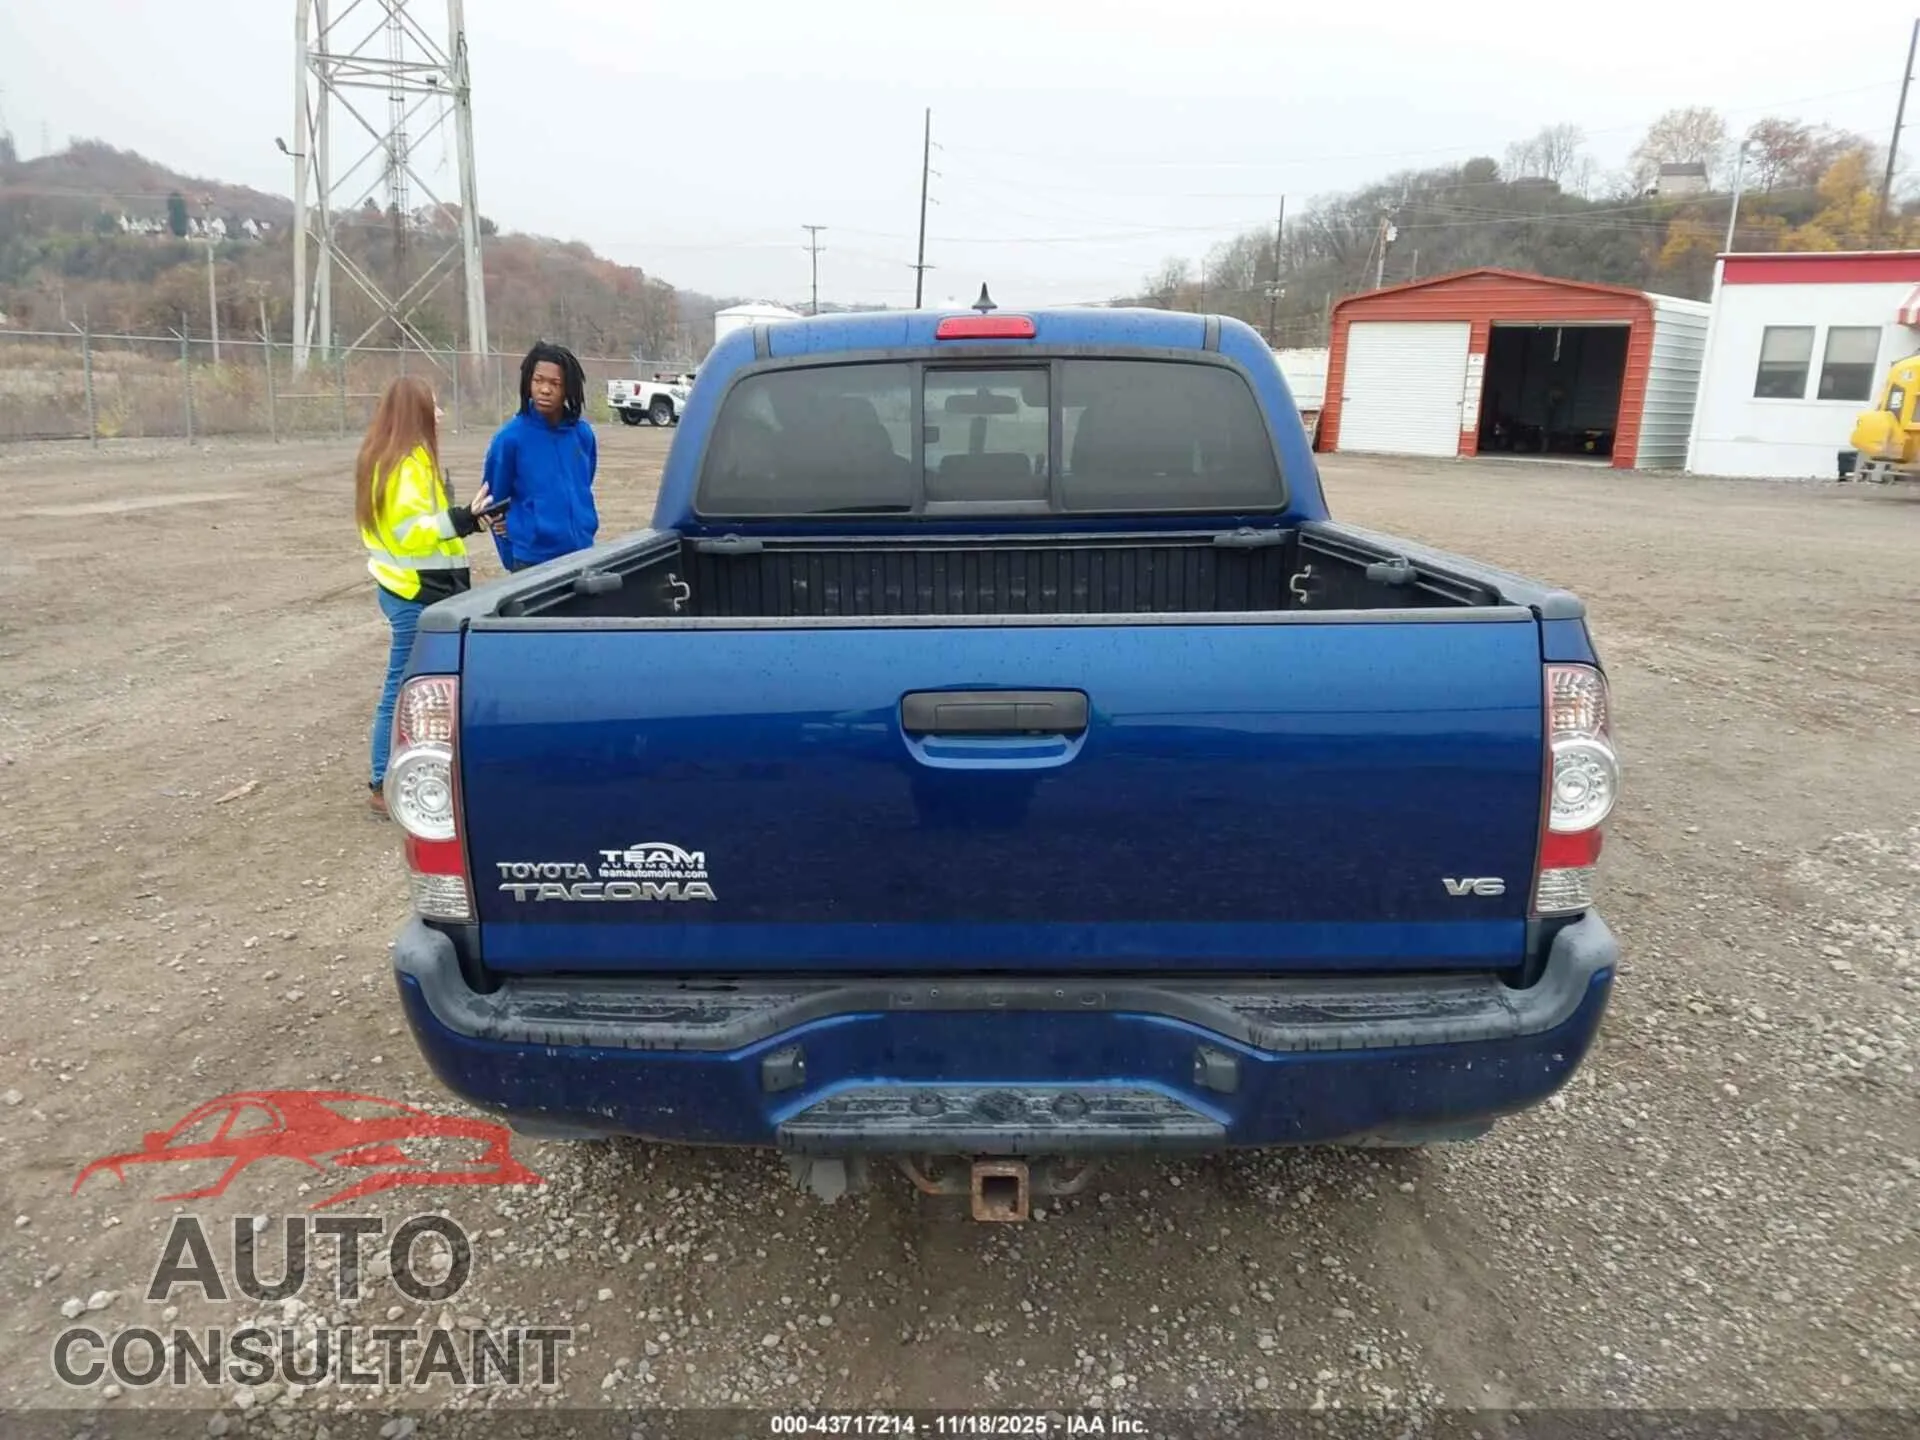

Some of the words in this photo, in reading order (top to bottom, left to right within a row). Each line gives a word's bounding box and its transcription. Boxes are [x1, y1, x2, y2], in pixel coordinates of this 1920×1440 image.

[600, 850, 705, 864] TEAM
[496, 862, 592, 879] TOYOTA
[599, 869, 708, 878] teamautomotive.com
[499, 882, 717, 902] TACOMA
[1442, 877, 1506, 896] V6
